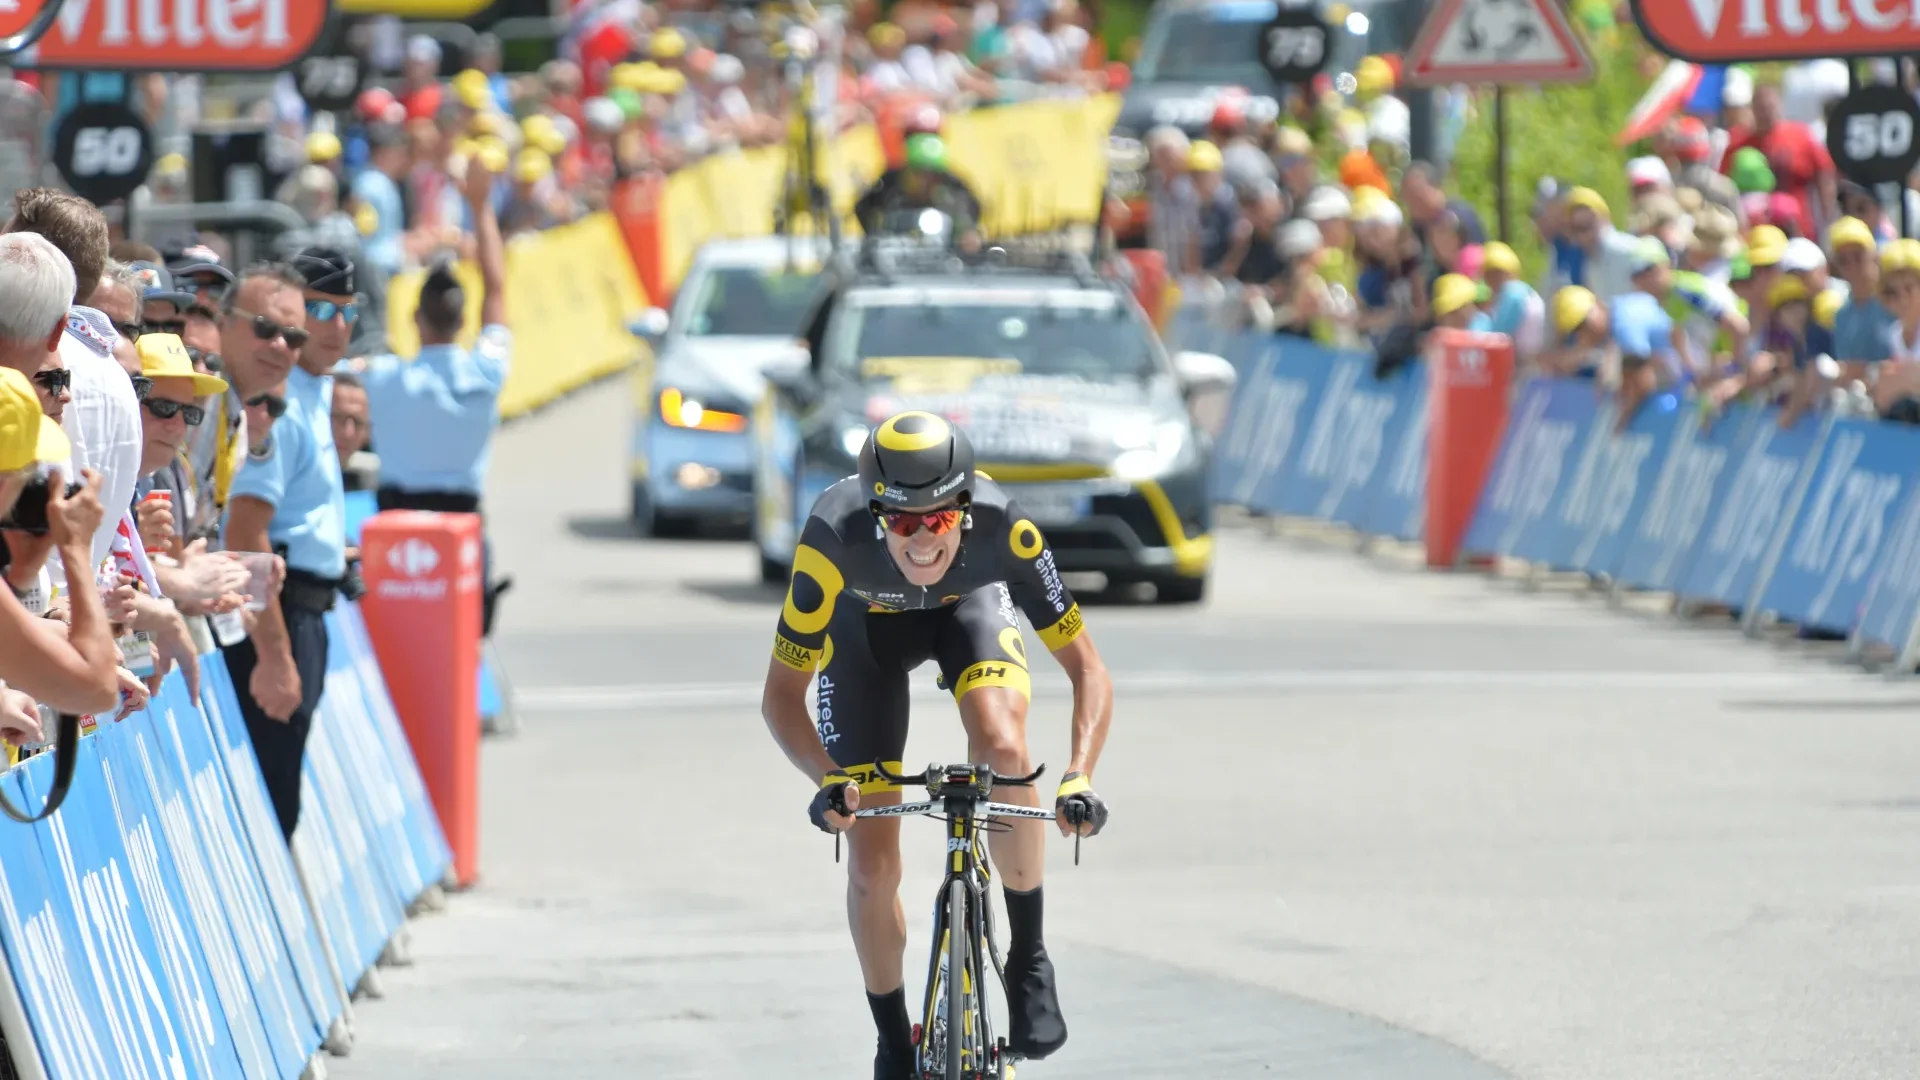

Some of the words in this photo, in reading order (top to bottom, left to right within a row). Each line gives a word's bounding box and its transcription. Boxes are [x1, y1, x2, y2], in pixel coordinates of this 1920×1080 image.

[71, 126, 142, 176] 50
[1844, 111, 1914, 161] 50
[885, 486, 904, 496] direct
[1035, 558, 1065, 613] energie
[966, 667, 1006, 682] BH
[820, 675, 841, 745] direct
[948, 838, 971, 852] BH
